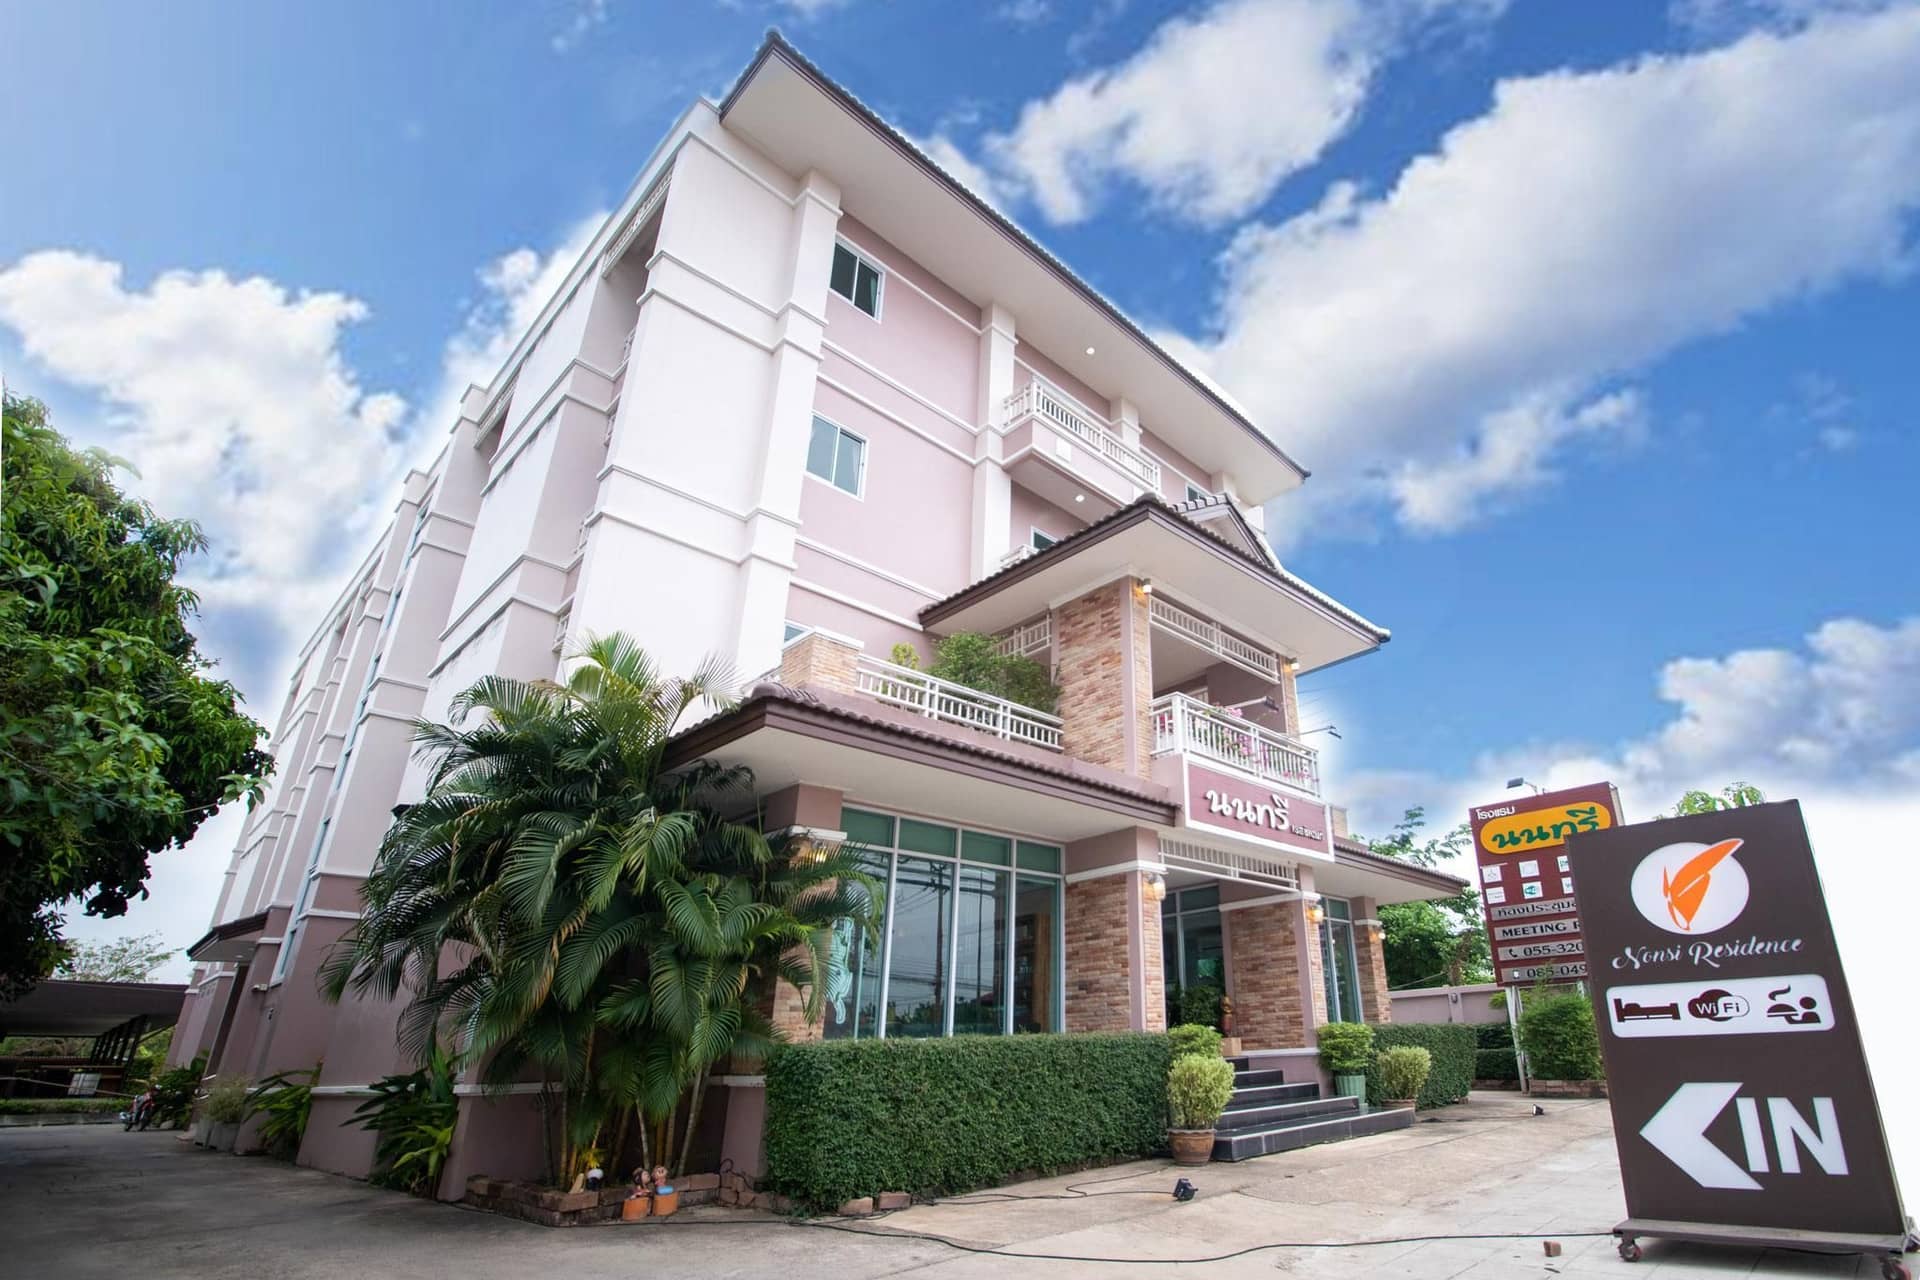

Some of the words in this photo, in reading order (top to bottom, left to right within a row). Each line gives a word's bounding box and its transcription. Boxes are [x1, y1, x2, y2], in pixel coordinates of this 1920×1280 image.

[1205, 789, 1290, 830] นนทรี
[1475, 805, 1516, 821] โรงแรม
[1491, 806, 1600, 848] นนทรี
[1498, 901, 1576, 917] ห้องประชุม
[1502, 922, 1567, 937] MEETING
[1612, 945, 1681, 970] Nonsi
[1689, 936, 1803, 968] Residence
[1735, 1096, 1849, 1176] IN
